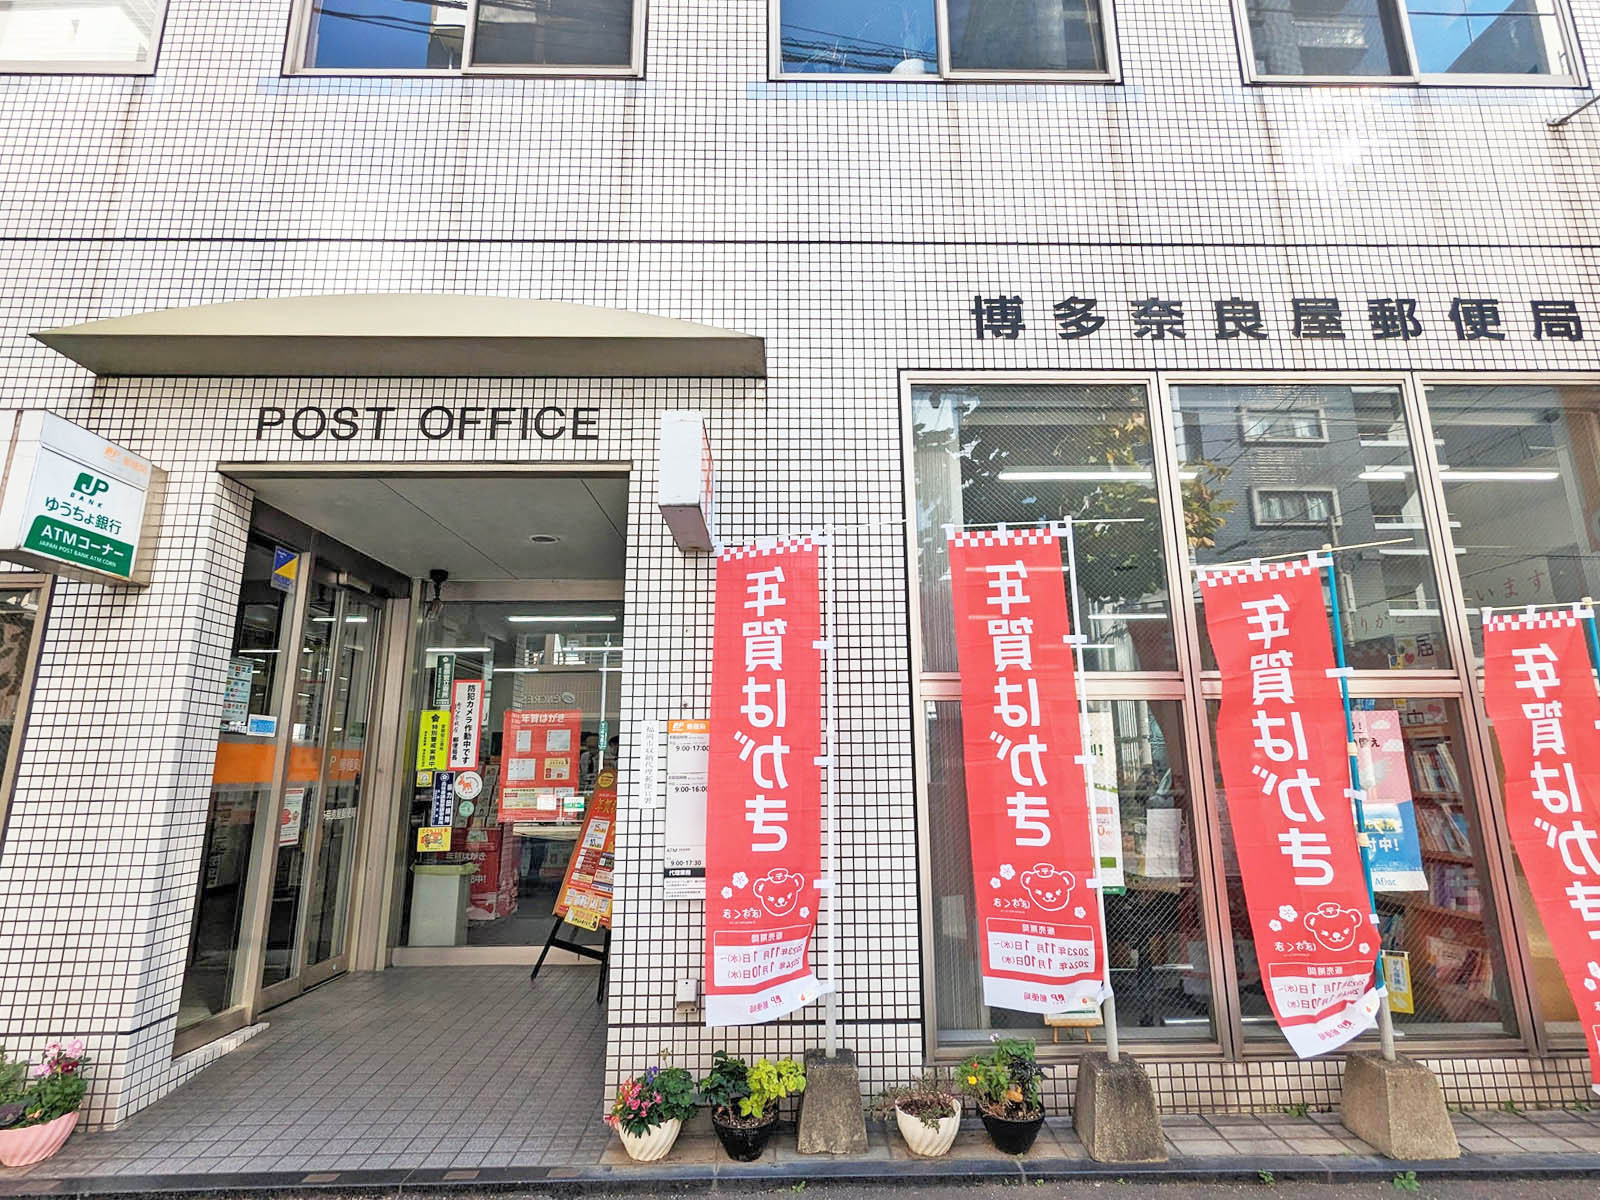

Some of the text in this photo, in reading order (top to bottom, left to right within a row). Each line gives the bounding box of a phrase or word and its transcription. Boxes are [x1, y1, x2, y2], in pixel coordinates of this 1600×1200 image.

[971, 295, 1585, 341] 博多奈良屋郵便局
[256, 405, 599, 440] POST OFFICE
[70, 492, 103, 508] BANK
[73, 472, 109, 496] JP
[45, 496, 122, 535] ゆうちょ銀行
[39, 540, 58, 550] JAPAN
[58, 545, 73, 554] POST
[73, 550, 89, 559] BANK
[89, 554, 102, 563] ATM
[41, 524, 124, 557] ATMコーナー
[462, 685, 476, 764] 防犯カメラ作動中です
